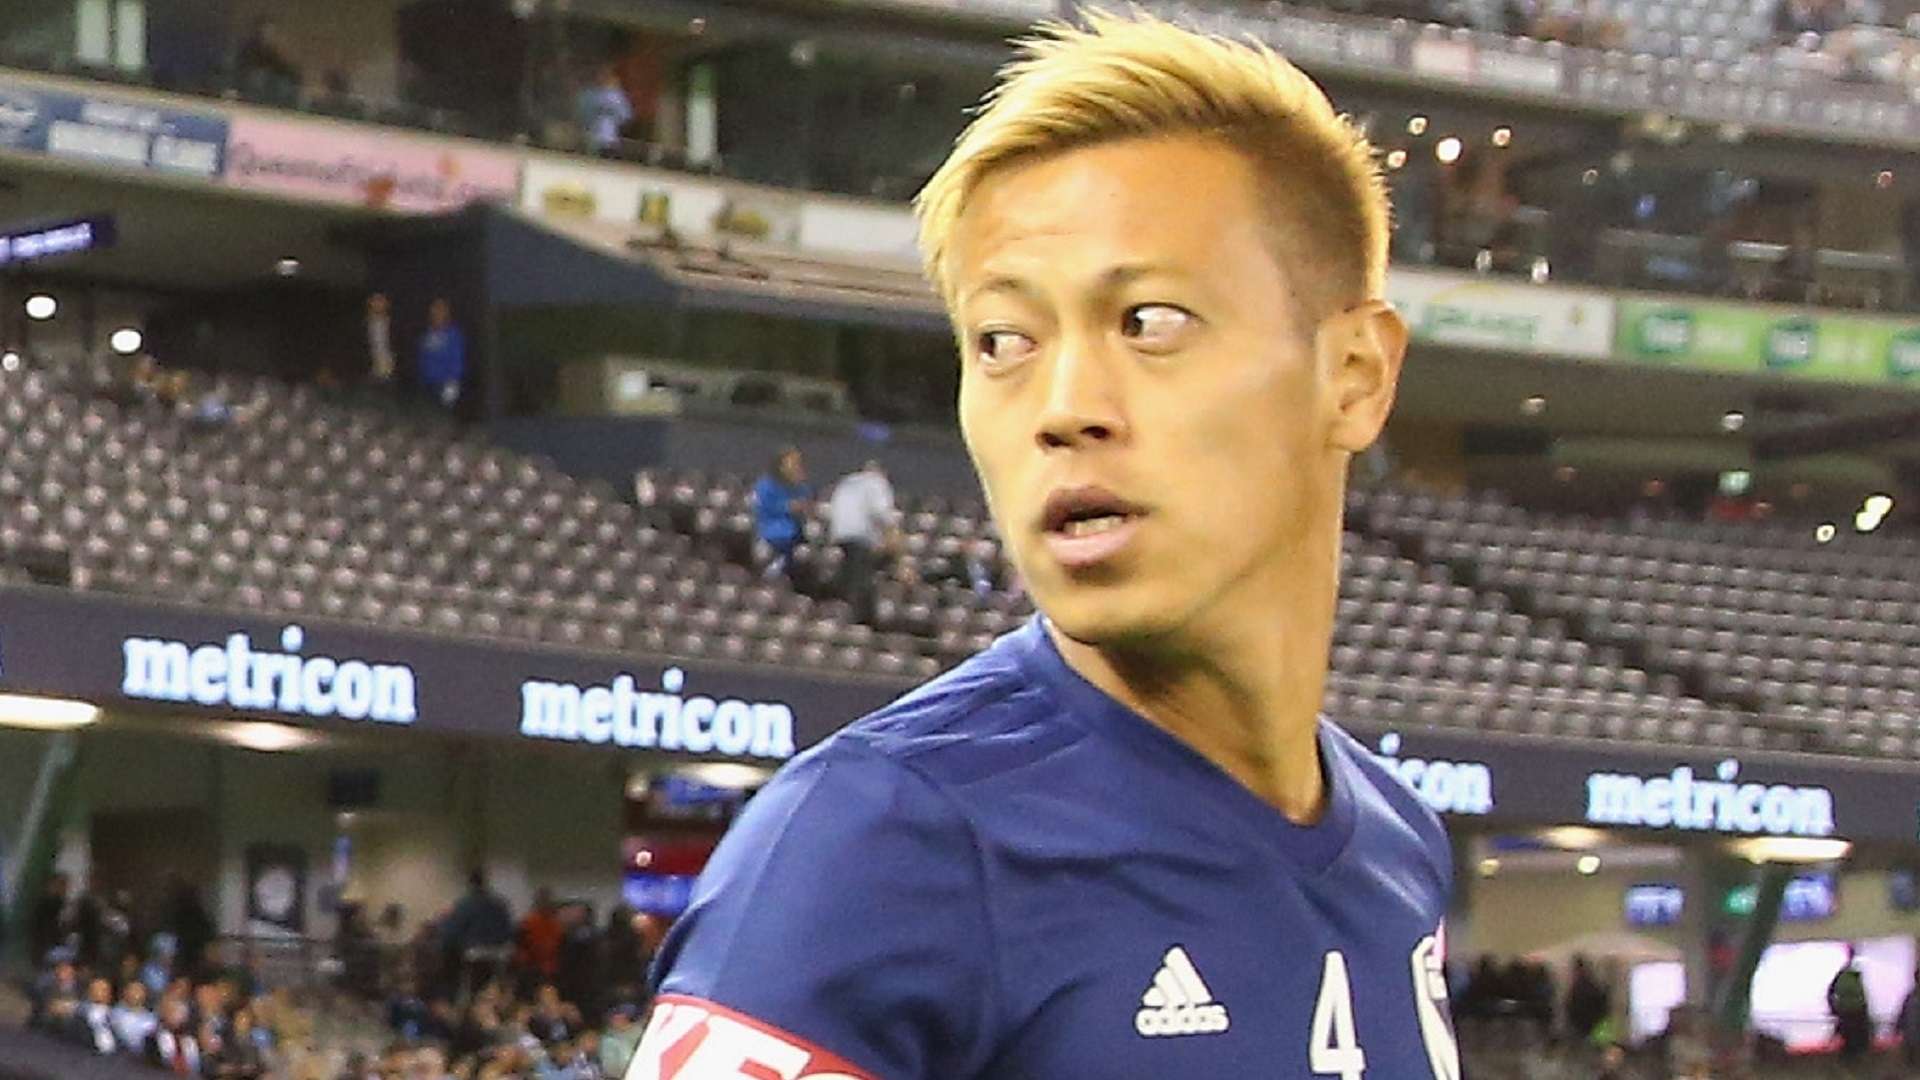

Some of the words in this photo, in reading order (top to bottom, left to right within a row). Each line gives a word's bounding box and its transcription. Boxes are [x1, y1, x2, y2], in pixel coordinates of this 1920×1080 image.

[122, 624, 416, 723] metricon
[520, 666, 796, 759] metricon
[1374, 732, 1494, 815] icon
[1585, 757, 1834, 836] metricon
[1135, 1004, 1229, 1036] adidas
[1309, 950, 1365, 1080] 4
